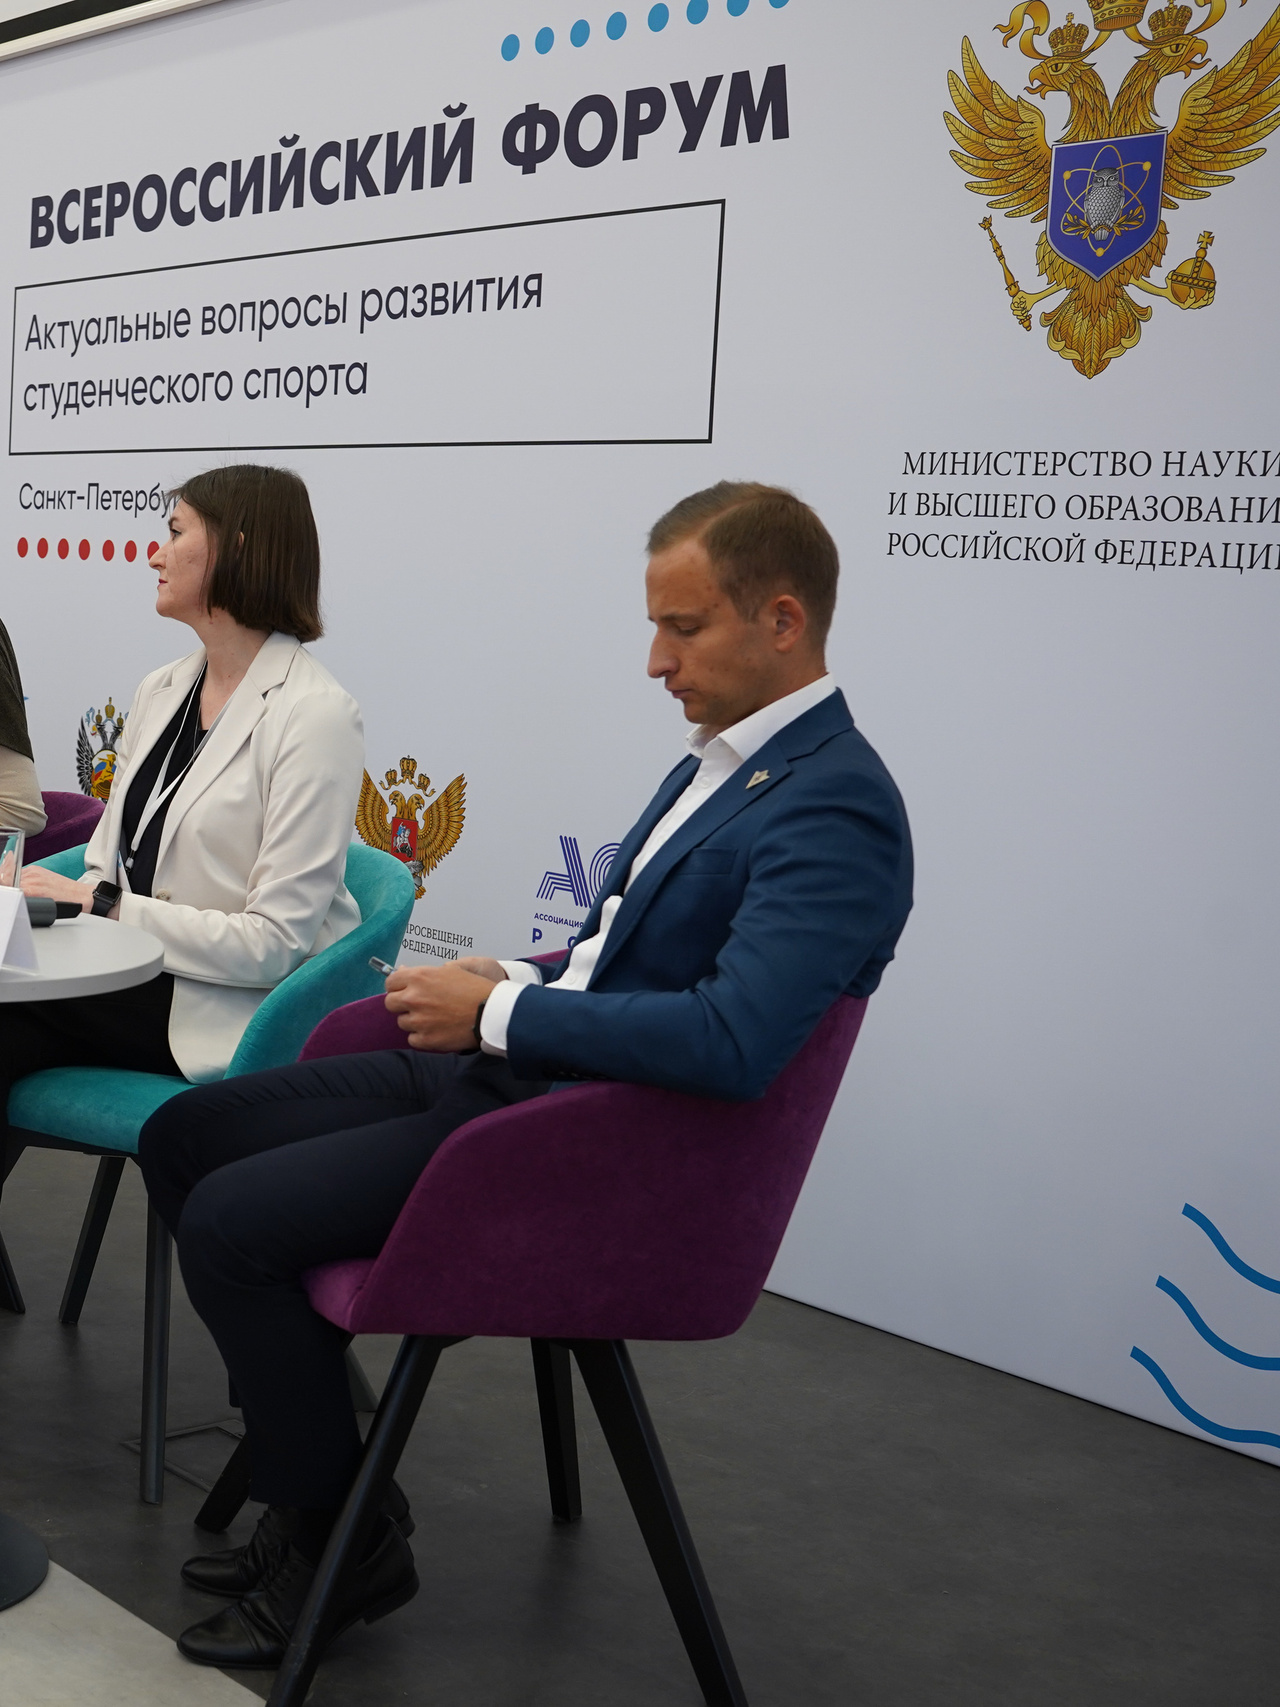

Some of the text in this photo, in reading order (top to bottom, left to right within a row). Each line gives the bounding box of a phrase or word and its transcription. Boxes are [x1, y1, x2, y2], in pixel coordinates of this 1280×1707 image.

[30, 64, 789, 249] ВСЕРОССИЙСКИЙ ФОРУМ
[25, 273, 543, 357] Актуальные вопросы развития
[23, 362, 368, 420] студенческого спорта
[902, 450, 1280, 478] МИНИСТЕРСТВО НАУКИ
[888, 492, 907, 516] И
[915, 492, 1056, 519] ВЫСШЕГО
[887, 530, 1280, 575] РОССИЙСКОЙ ФЕДЕРАЦИ
[401, 938, 458, 960] ФЕДЕРАЦИИ
